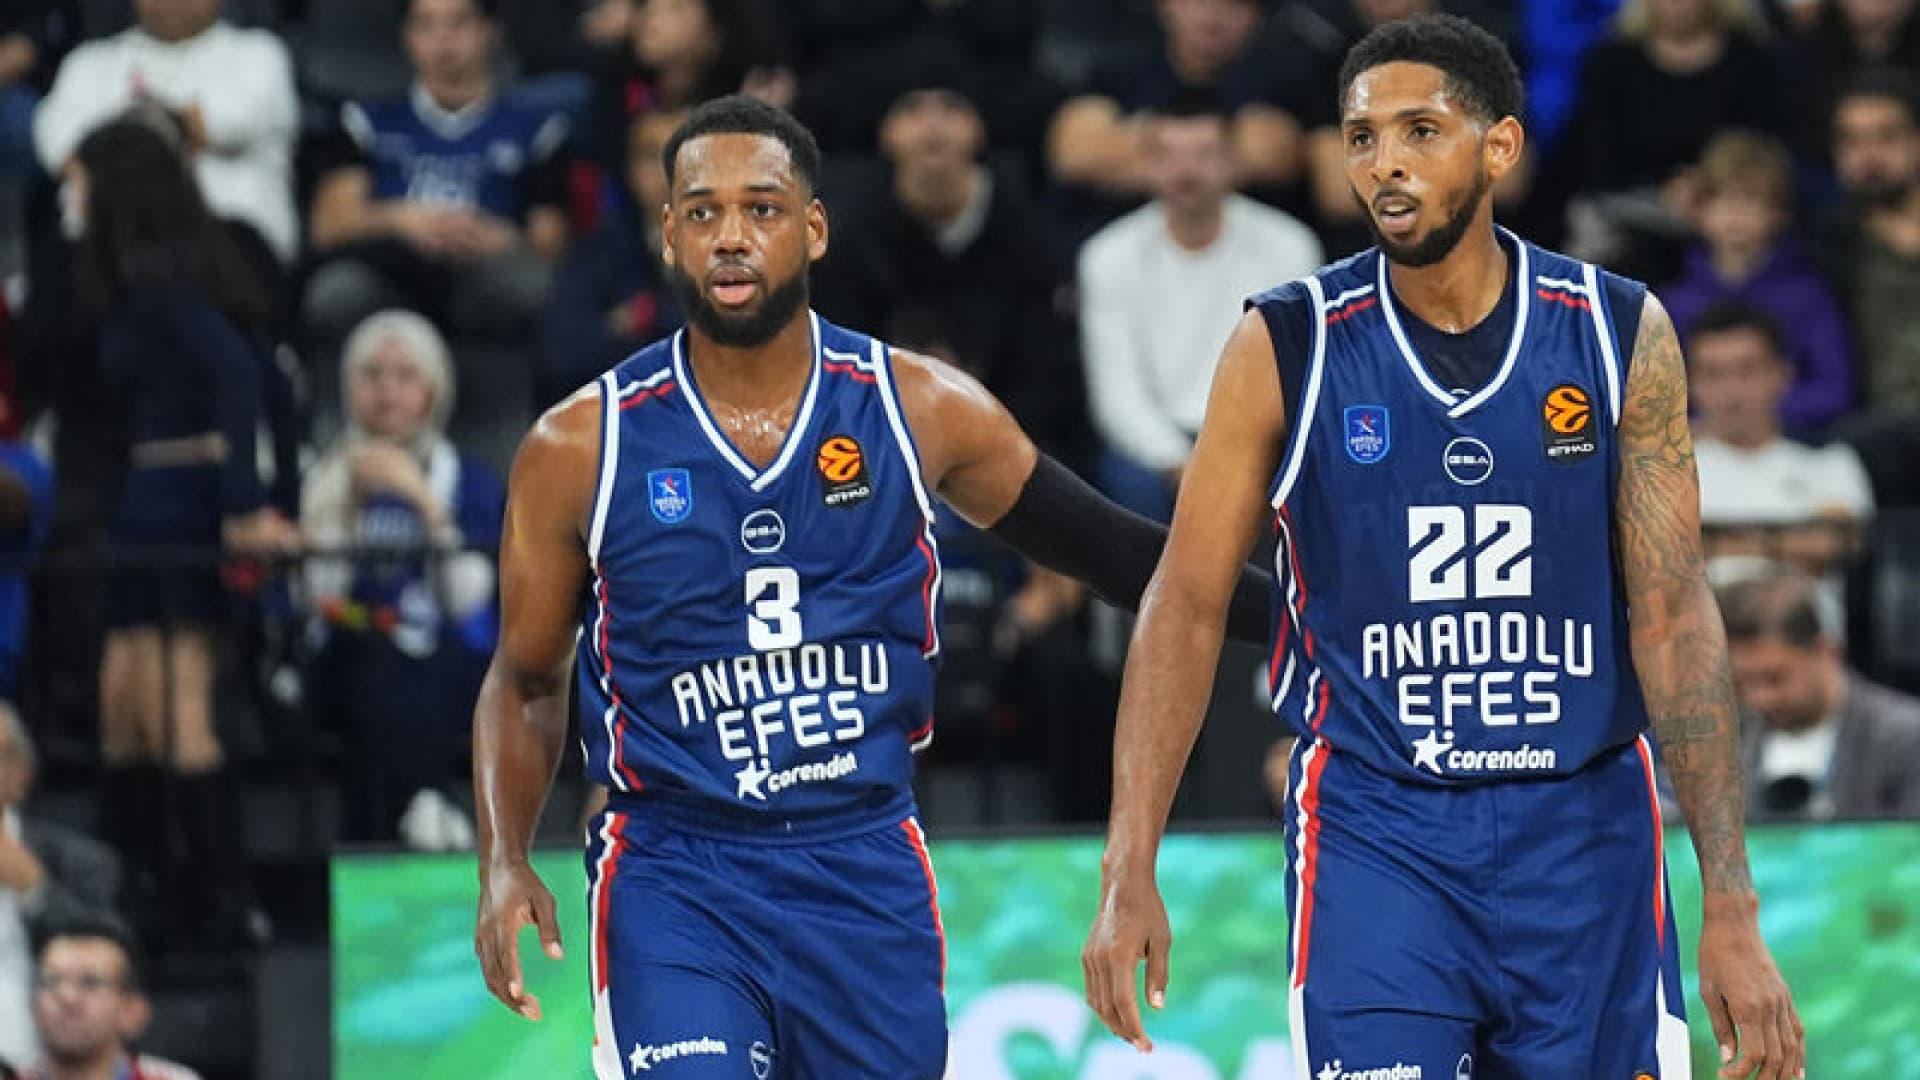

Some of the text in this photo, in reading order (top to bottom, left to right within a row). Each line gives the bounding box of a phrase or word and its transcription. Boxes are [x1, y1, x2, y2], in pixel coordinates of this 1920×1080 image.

[1408, 503, 1532, 603] 22
[745, 566, 803, 651] 3
[1362, 611, 1594, 680] ANADOLU
[671, 642, 889, 728] ANADOLU
[1398, 671, 1562, 727] EFES
[714, 690, 865, 760] EFES
[1448, 744, 1556, 770] corendon
[767, 752, 857, 793] corendon
[652, 1036, 728, 1063] corendon
